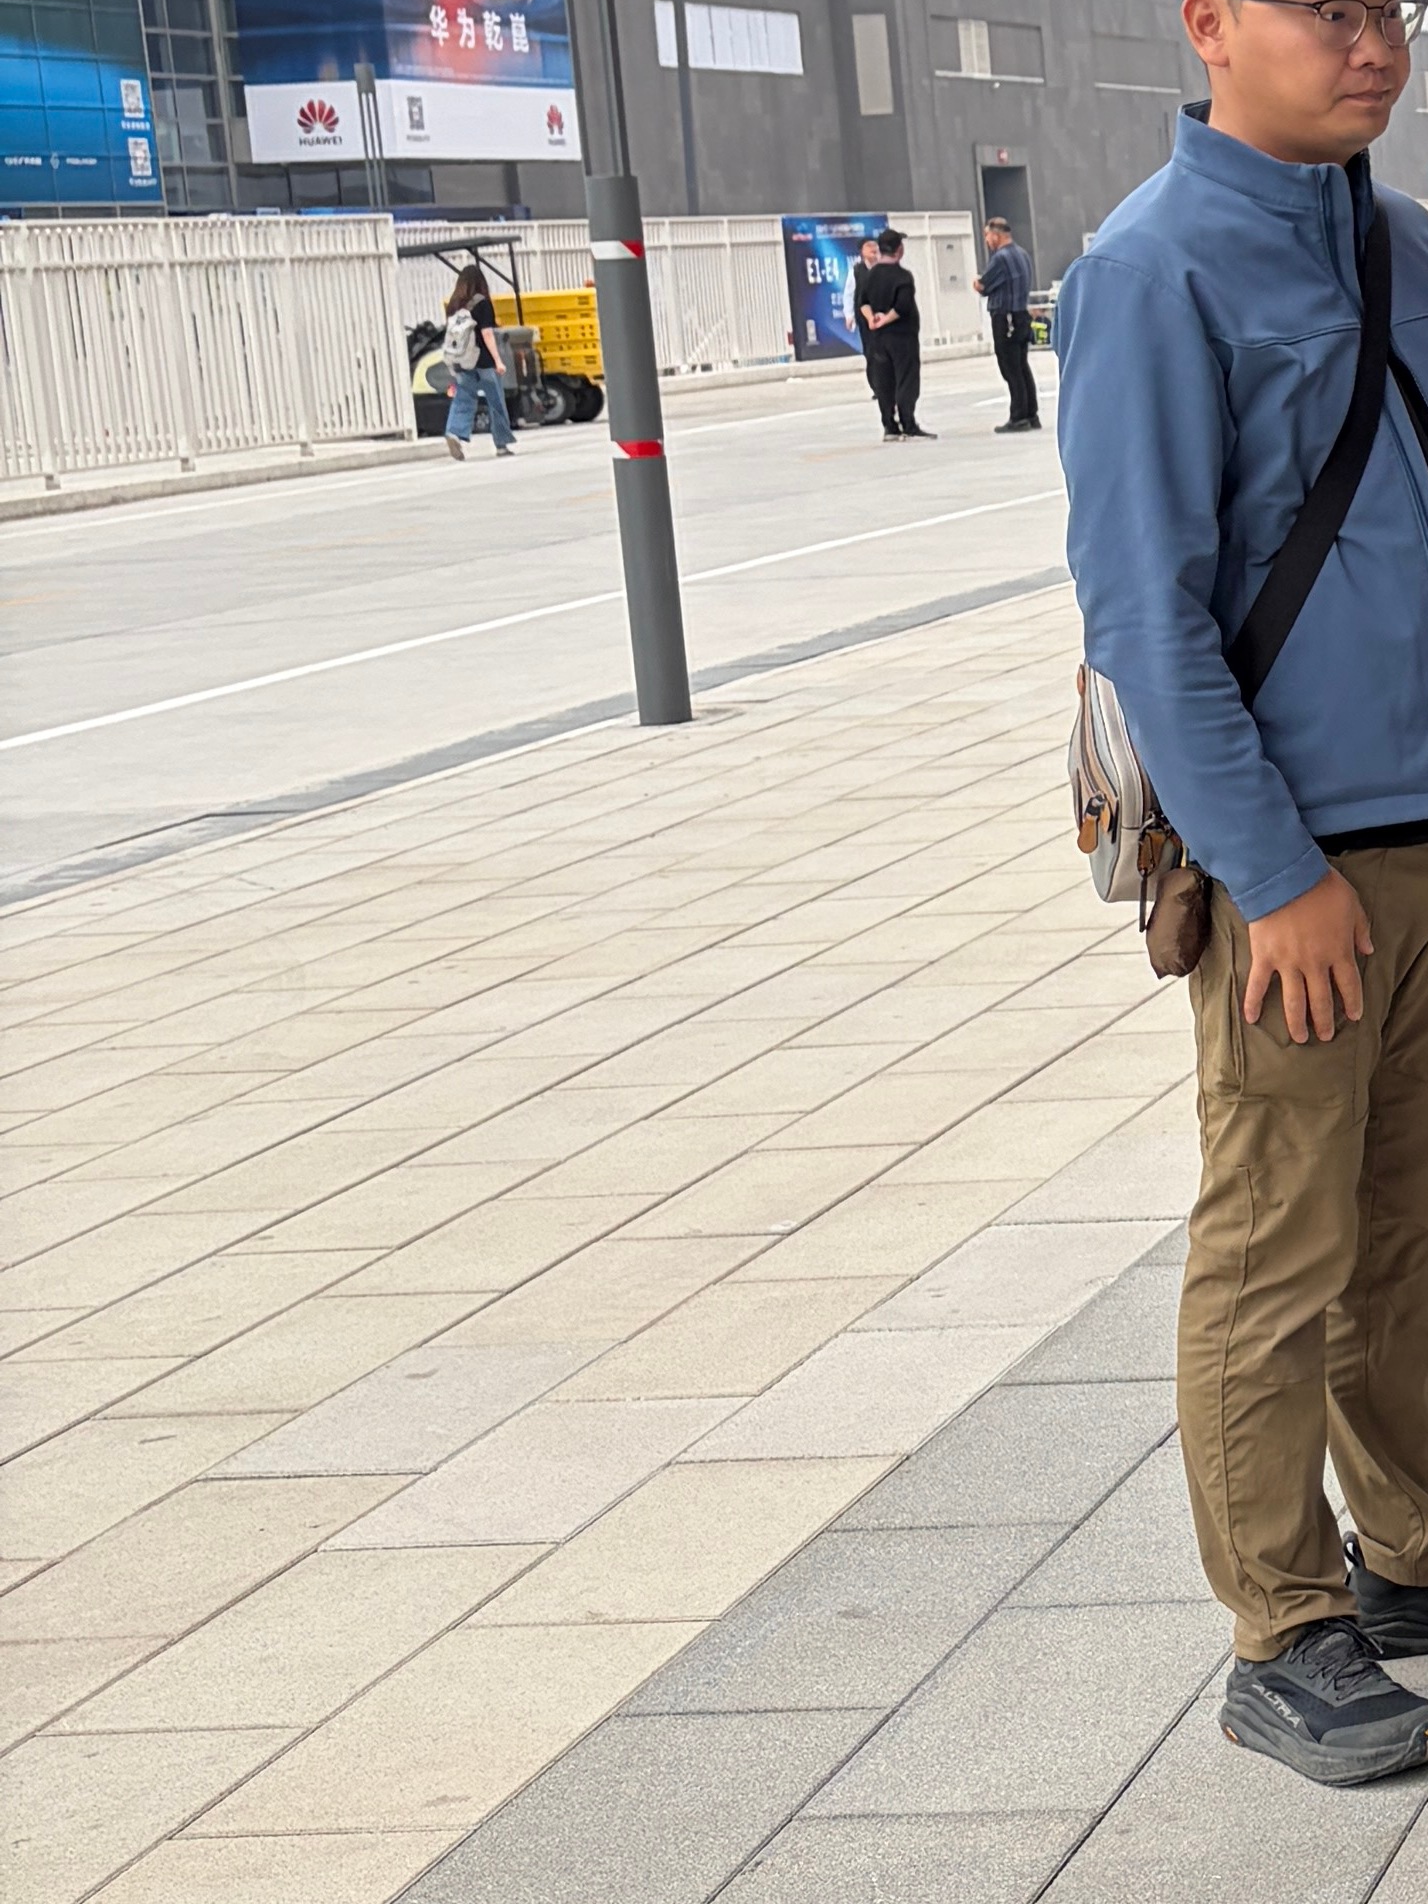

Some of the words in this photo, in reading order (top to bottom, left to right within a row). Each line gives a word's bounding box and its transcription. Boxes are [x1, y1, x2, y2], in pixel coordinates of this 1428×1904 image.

[429, 5, 530, 54] 华为乾崑
[298, 135, 343, 147] HUAWEI
